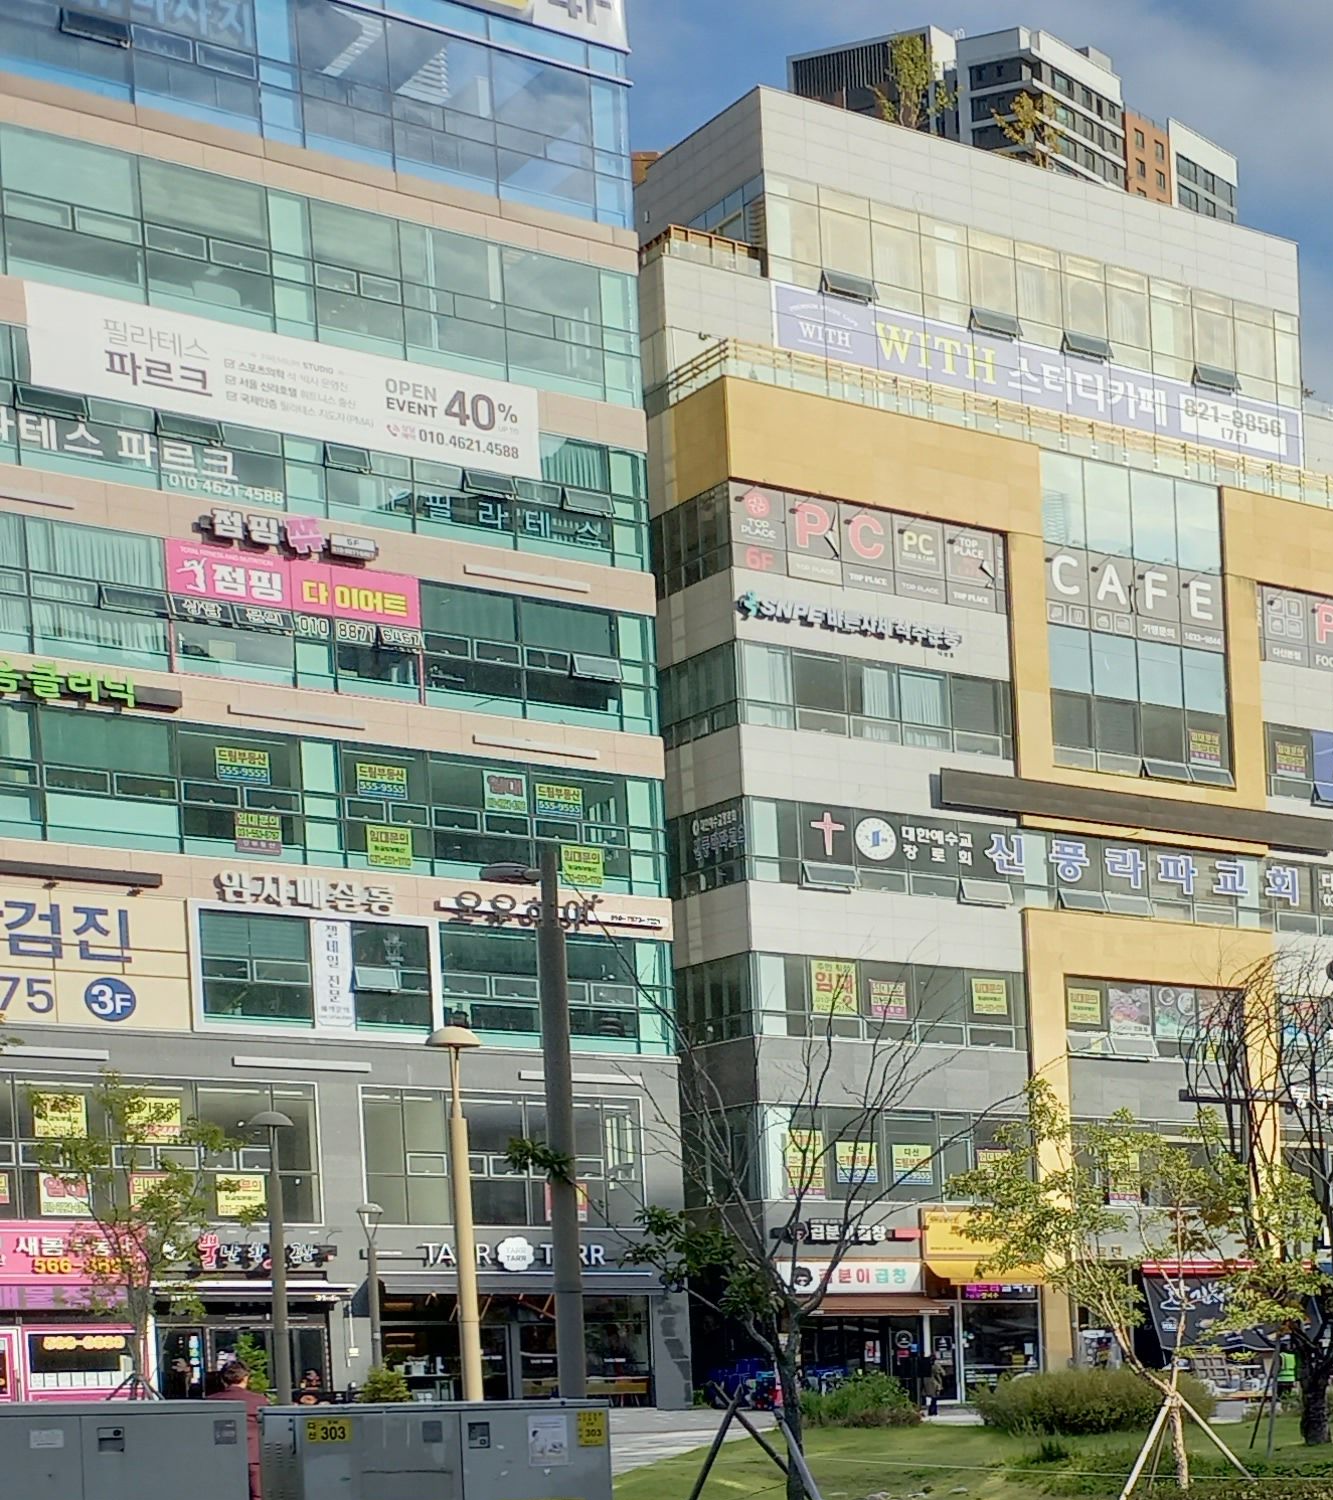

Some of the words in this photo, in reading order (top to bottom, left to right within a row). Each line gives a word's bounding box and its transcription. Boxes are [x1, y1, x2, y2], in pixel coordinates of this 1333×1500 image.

[104, 319, 210, 361] 필라테스
[799, 321, 852, 348] WITH
[104, 350, 213, 397] 파르크
[876, 320, 997, 385] WITH
[1007, 356, 1168, 427] 스터디카페
[385, 378, 438, 402] OPEN
[386, 396, 438, 419] EVENT
[419, 429, 519, 459] 010.4621.4588
[117, 430, 239, 481] 파르크
[169, 473, 197, 489] 010
[425, 493, 602, 548] 필라테스
[747, 518, 769, 529] TOP
[794, 501, 884, 560] PC
[741, 525, 776, 540] PLACE
[903, 530, 934, 556] PC
[958, 536, 978, 547] TOP
[745, 547, 774, 570] 6F
[953, 544, 984, 560] PLACE
[212, 563, 283, 602] 점핑
[849, 573, 863, 583] TOP
[865, 575, 888, 586] PLACE
[1051, 554, 1213, 621] CAFE
[953, 591, 968, 600] TOP
[968, 593, 989, 604] PLACE
[300, 615, 330, 636] 010
[338, 621, 376, 643] 8871
[217, 749, 267, 764] 드림부동산
[358, 767, 405, 782] 드림부동산
[537, 784, 580, 801] 드림부동산
[237, 812, 280, 827] 임대문의
[369, 830, 409, 846] 임대문의
[901, 825, 973, 848] 대한예수교
[564, 849, 600, 864] 임대문의
[90, 983, 132, 1016] 3F
[422, 1243, 492, 1265] TAR
[540, 1244, 606, 1265] TRR
[320, 1425, 346, 1441] 303
[585, 1428, 602, 1438] 303
